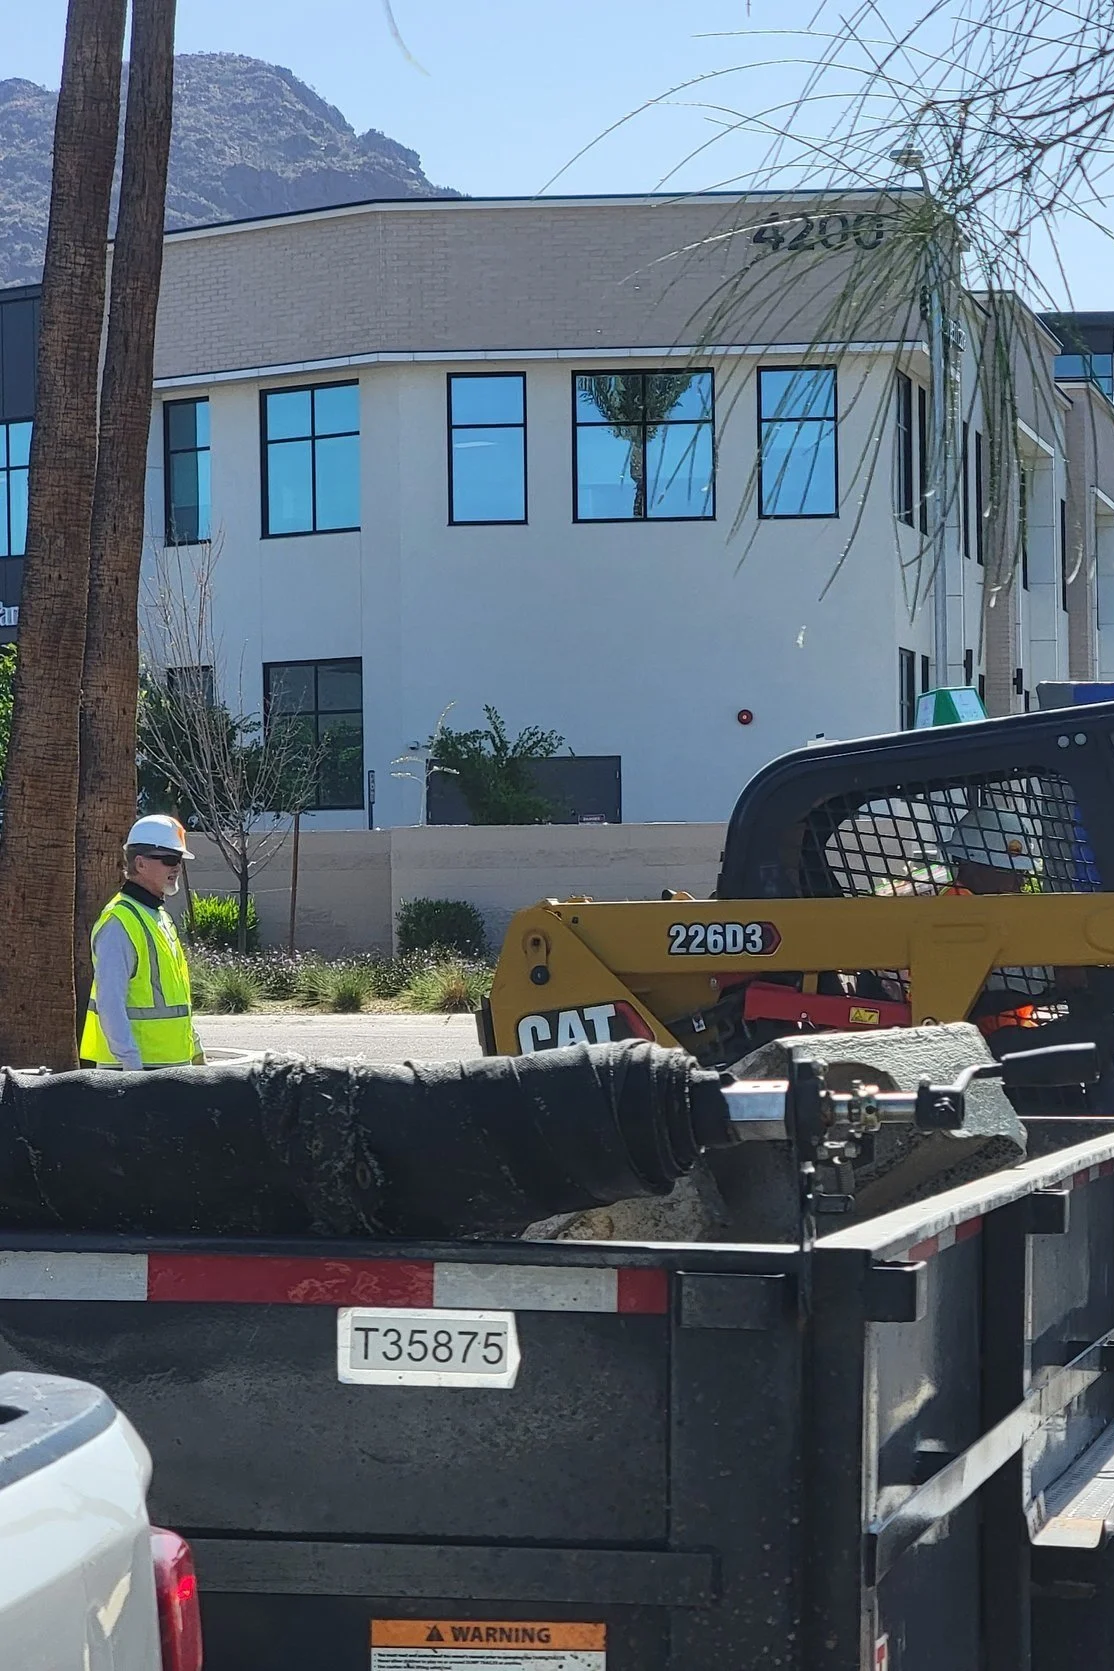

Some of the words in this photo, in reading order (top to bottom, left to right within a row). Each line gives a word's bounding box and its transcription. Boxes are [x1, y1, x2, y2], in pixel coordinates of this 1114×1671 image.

[753, 212, 883, 250] 4200
[669, 923, 763, 953] 226D3
[518, 1004, 616, 1055] CAT
[354, 1327, 504, 1365] T35875
[451, 1626, 551, 1644] WARNING
